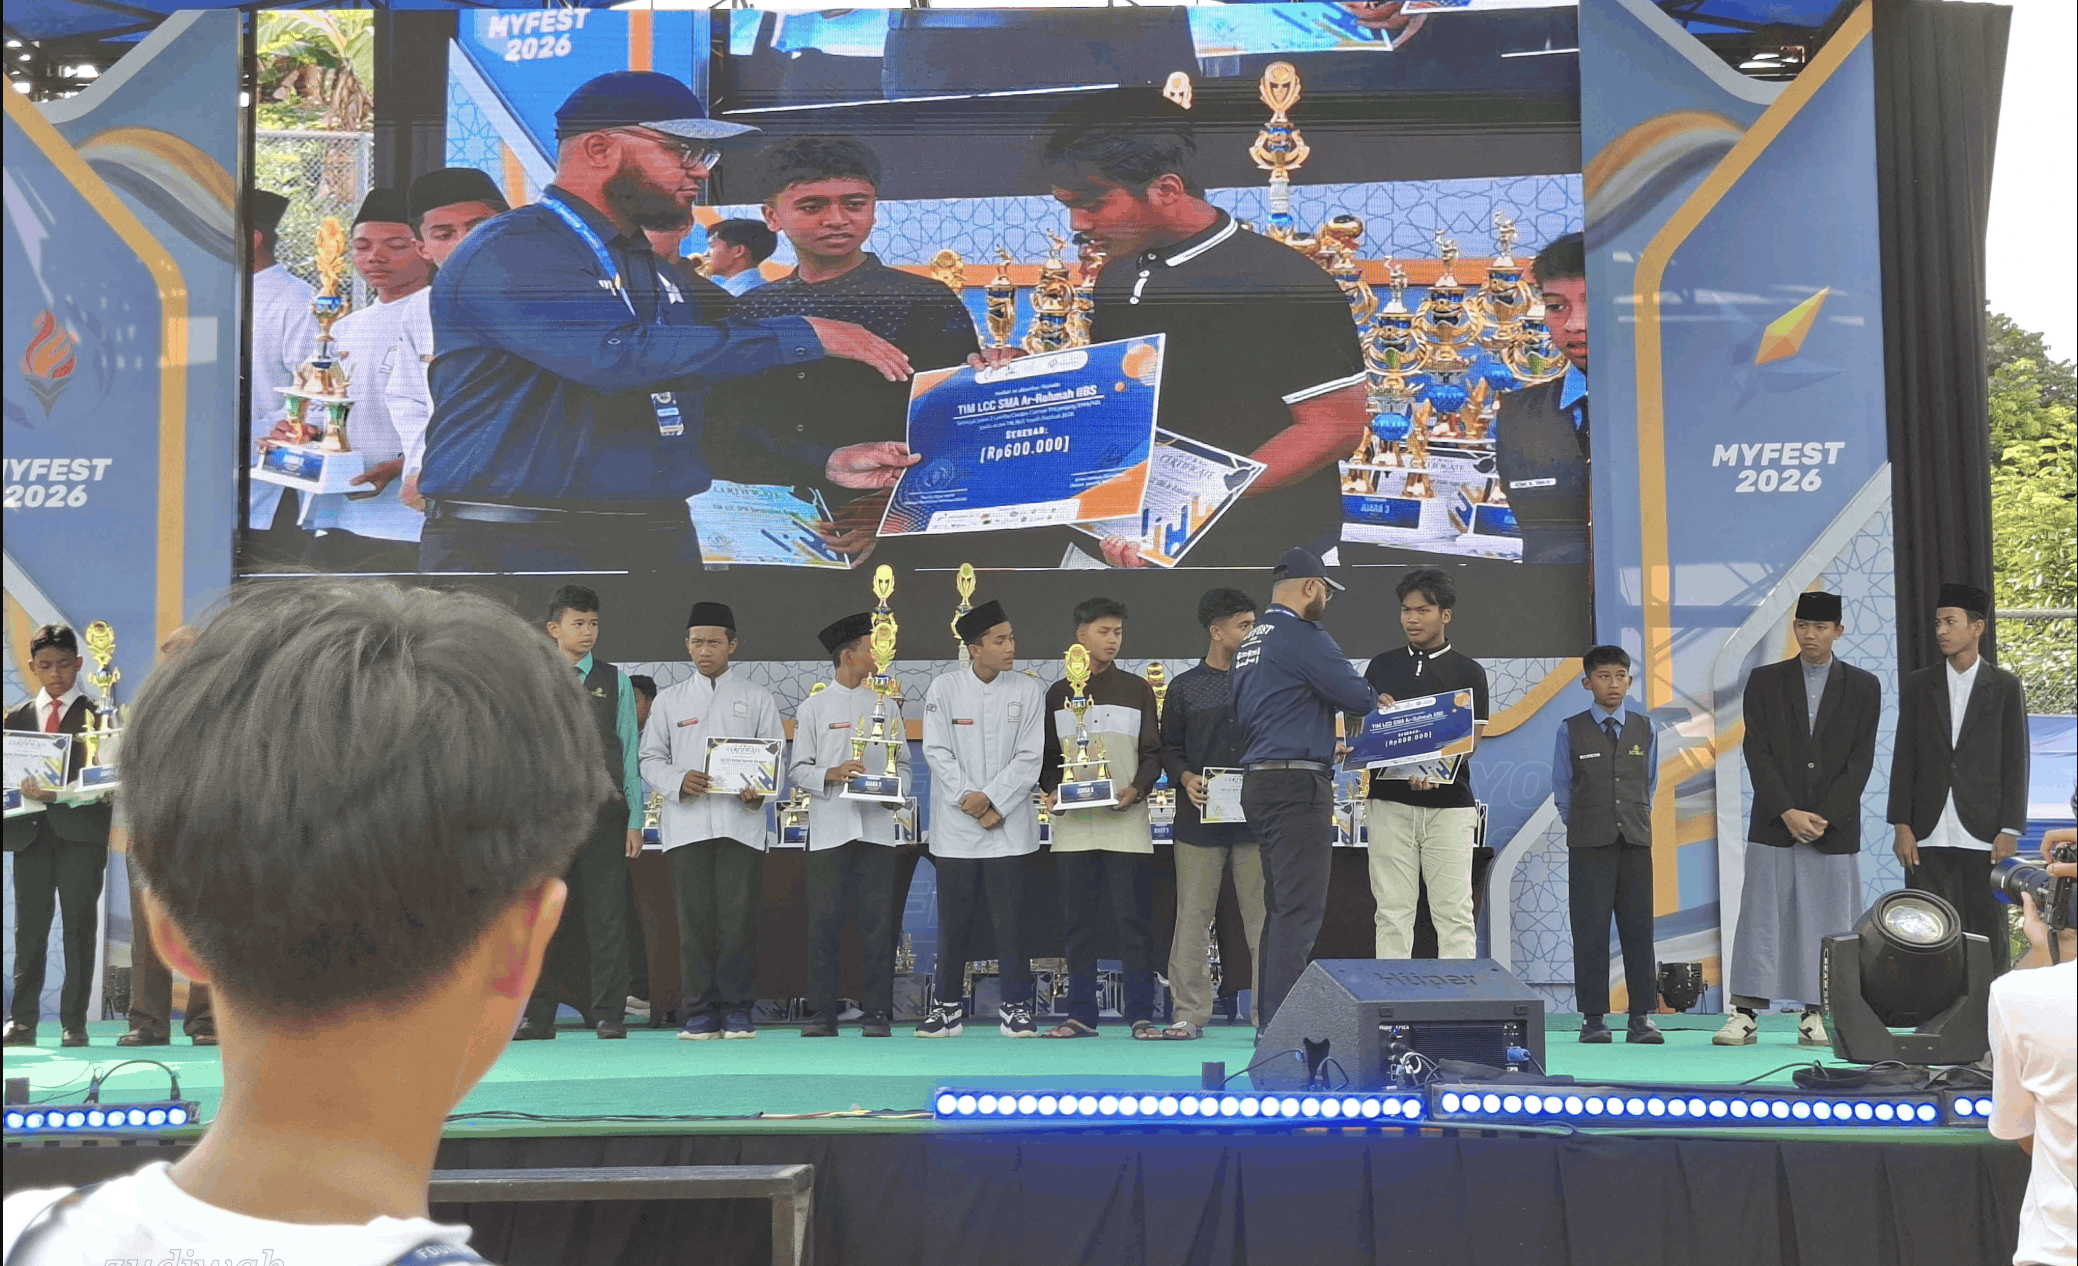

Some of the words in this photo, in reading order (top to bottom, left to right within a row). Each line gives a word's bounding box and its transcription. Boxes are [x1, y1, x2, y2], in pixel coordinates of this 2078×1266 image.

[488, 8, 592, 38] MYFEST
[504, 33, 572, 62] 2026
[957, 404, 976, 415] TIM
[977, 400, 996, 413] LCC
[998, 396, 1020, 410] SMA
[980, 435, 1070, 464] [Rp600.000]
[1712, 441, 1846, 467] MYFEST
[3, 458, 113, 481] YFEST
[1735, 468, 1822, 492] 2026
[3, 484, 88, 508] 2026
